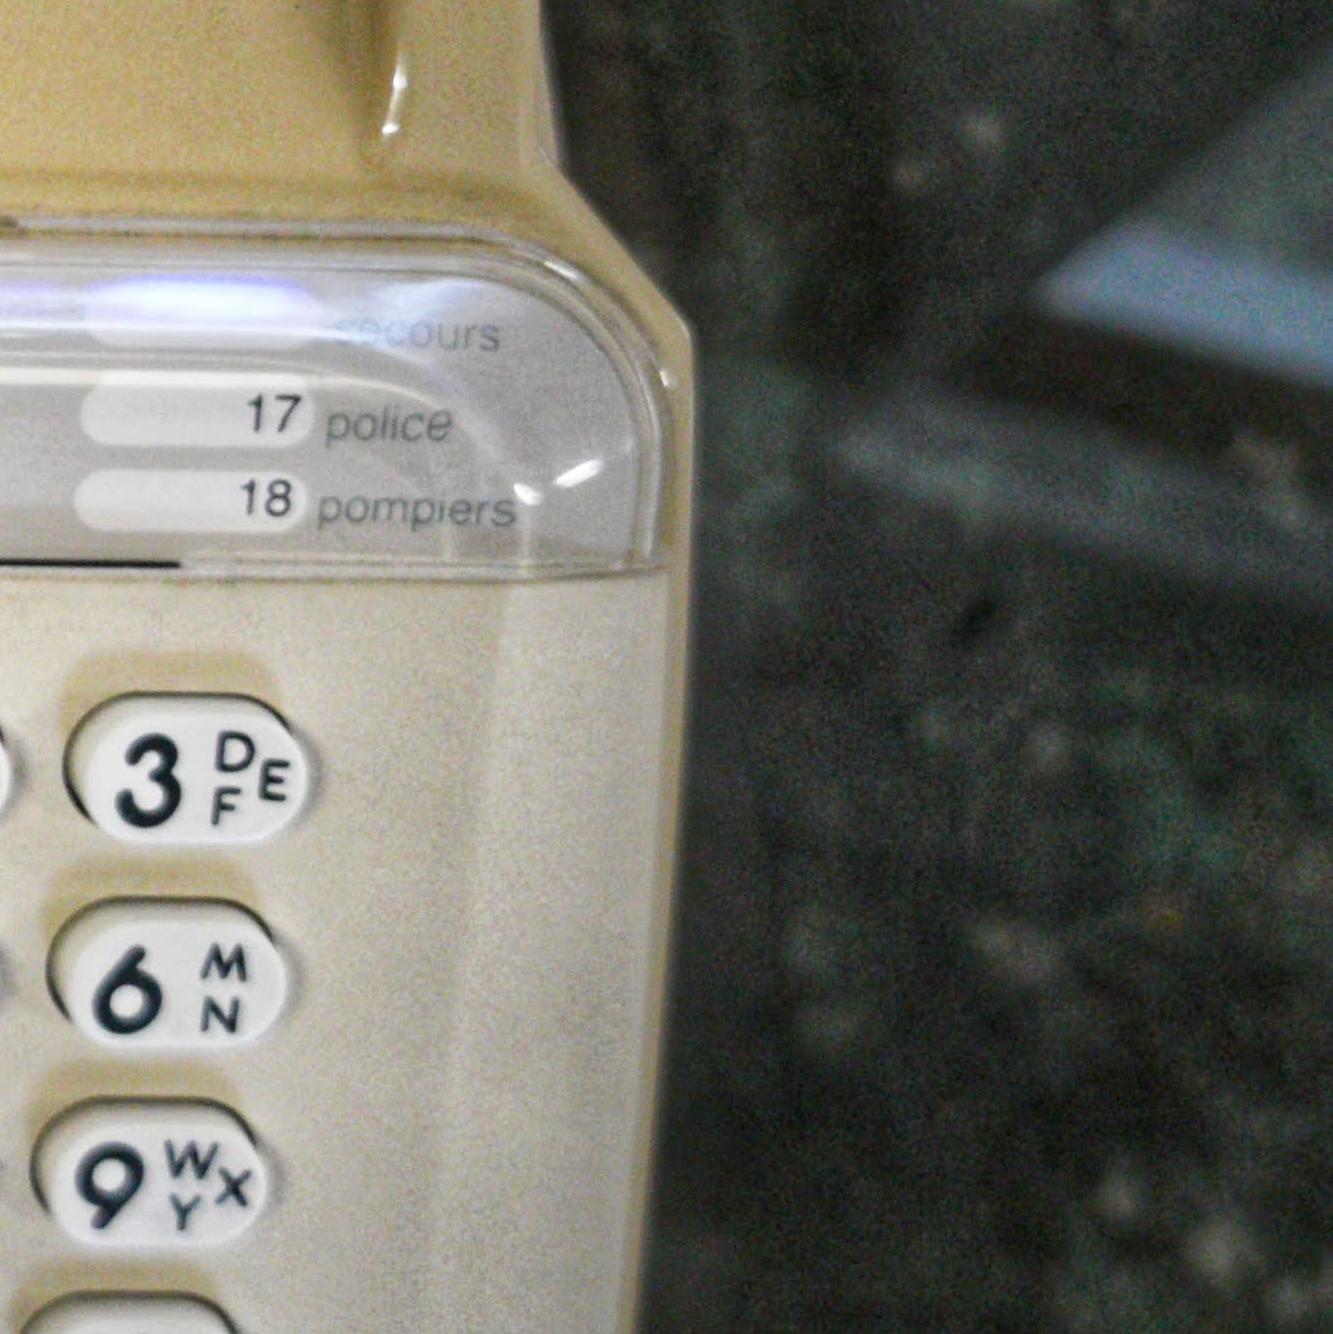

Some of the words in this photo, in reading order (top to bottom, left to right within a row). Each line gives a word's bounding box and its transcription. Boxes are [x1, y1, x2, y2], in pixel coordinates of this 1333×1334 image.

[246, 394, 302, 433] 17
[325, 404, 454, 447] police
[240, 479, 293, 518] 18
[317, 495, 517, 529] pompiers
[115, 731, 184, 831] 3
[92, 944, 165, 1037] 6
[74, 1142, 147, 1232] 9
